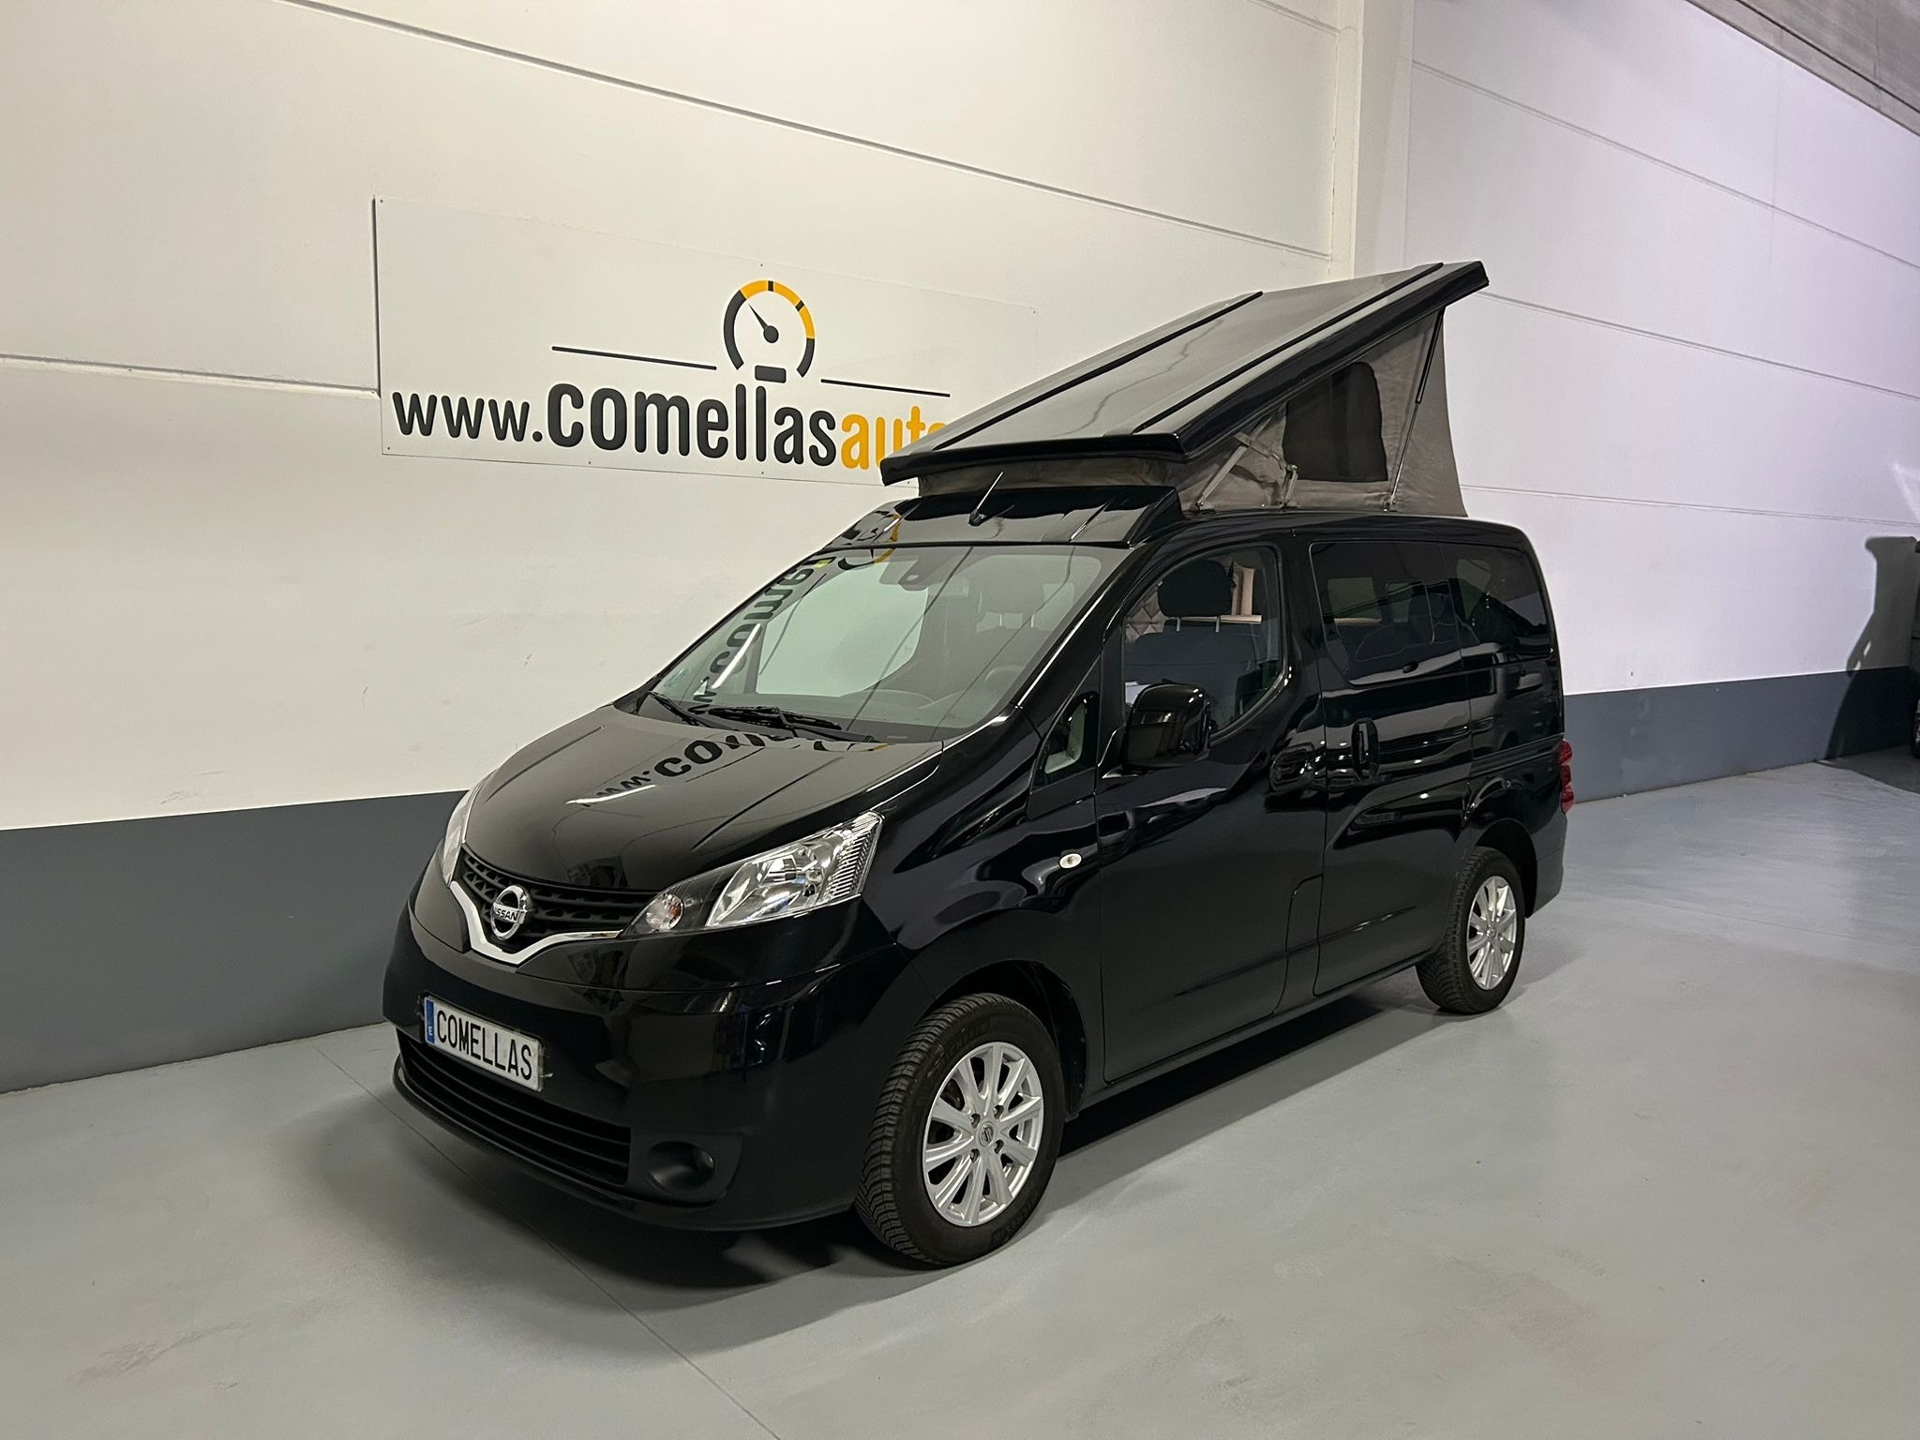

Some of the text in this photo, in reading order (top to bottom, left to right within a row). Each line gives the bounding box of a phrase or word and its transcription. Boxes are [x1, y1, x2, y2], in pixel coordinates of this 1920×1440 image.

[392, 383, 946, 469] www.comellasaut
[494, 904, 519, 921] SSAN
[437, 1010, 532, 1080] COMELLAS
